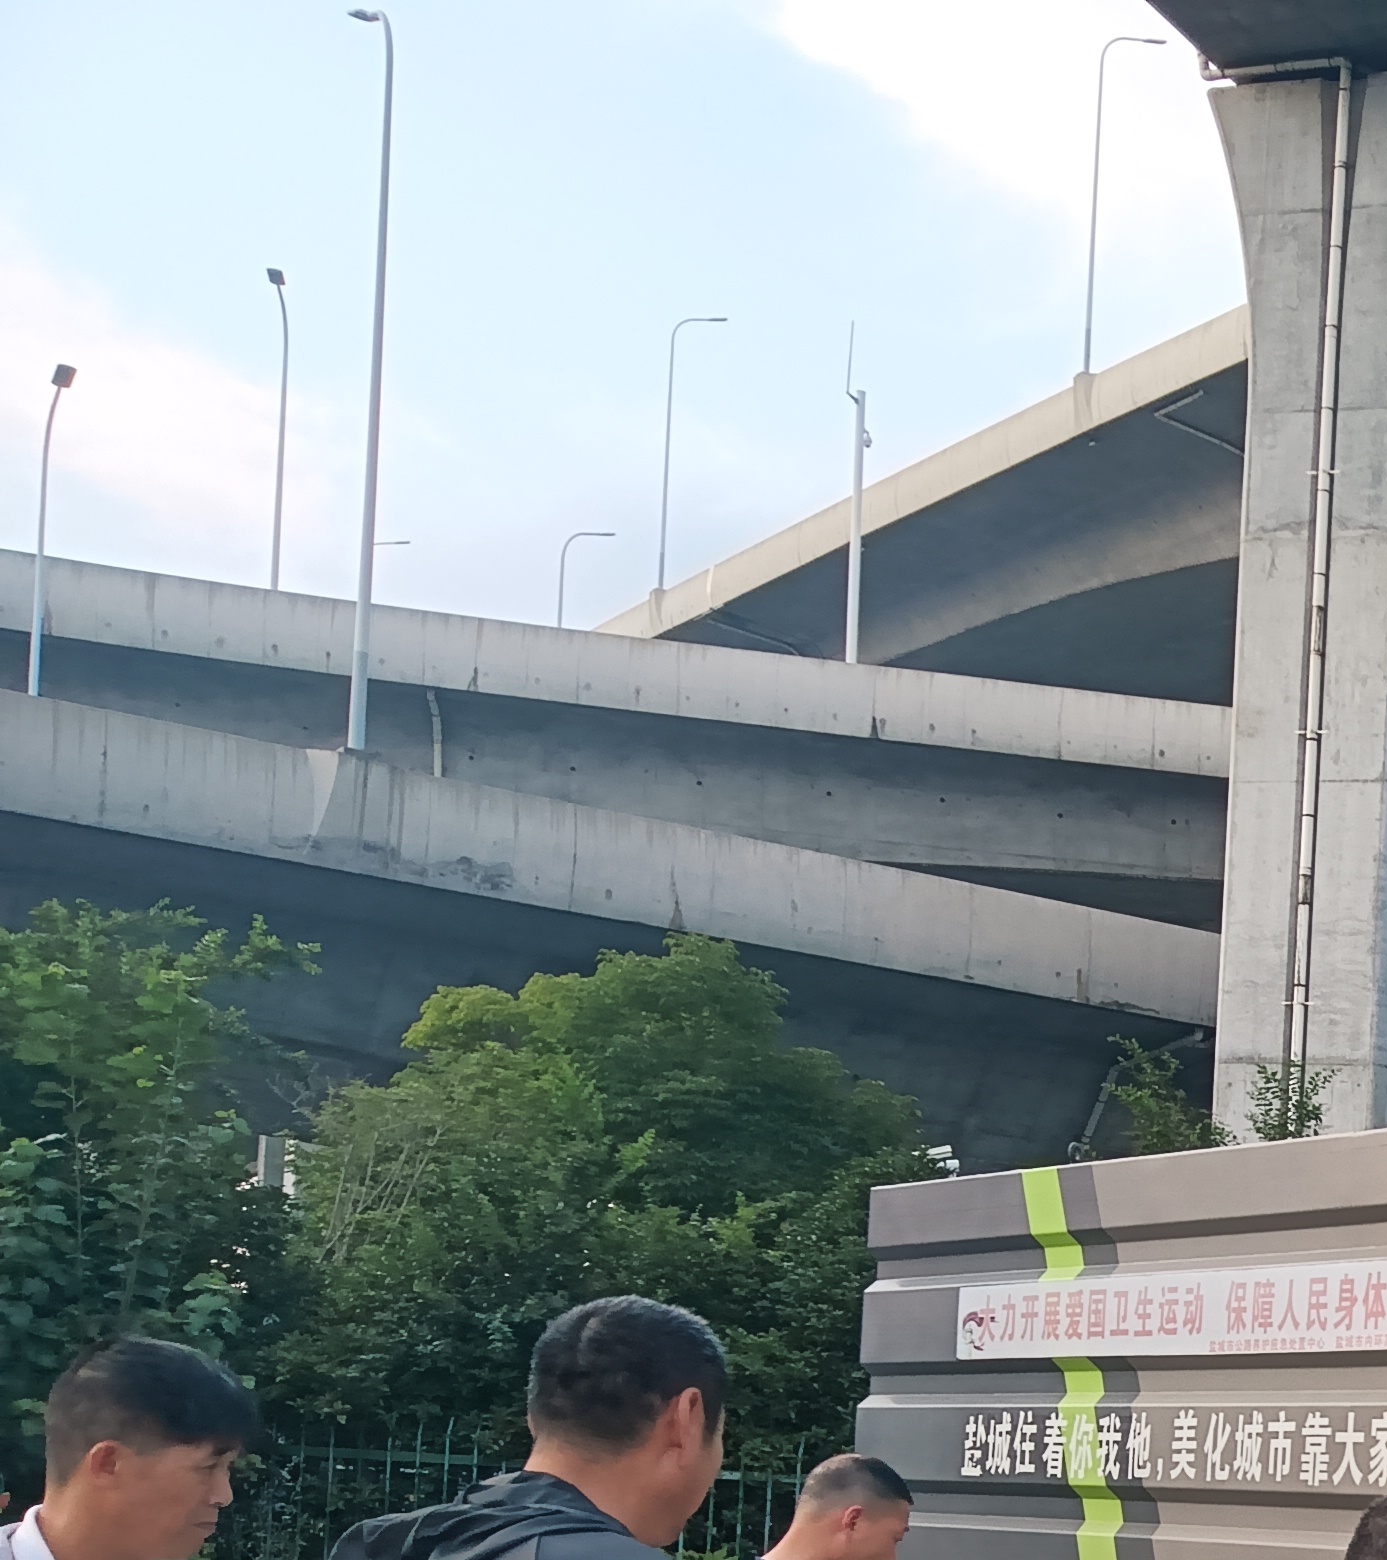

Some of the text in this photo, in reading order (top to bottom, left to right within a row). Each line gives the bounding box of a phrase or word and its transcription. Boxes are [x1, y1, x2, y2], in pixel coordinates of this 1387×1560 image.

[977, 1282, 1205, 1343] 大力开展爱国卫生运动
